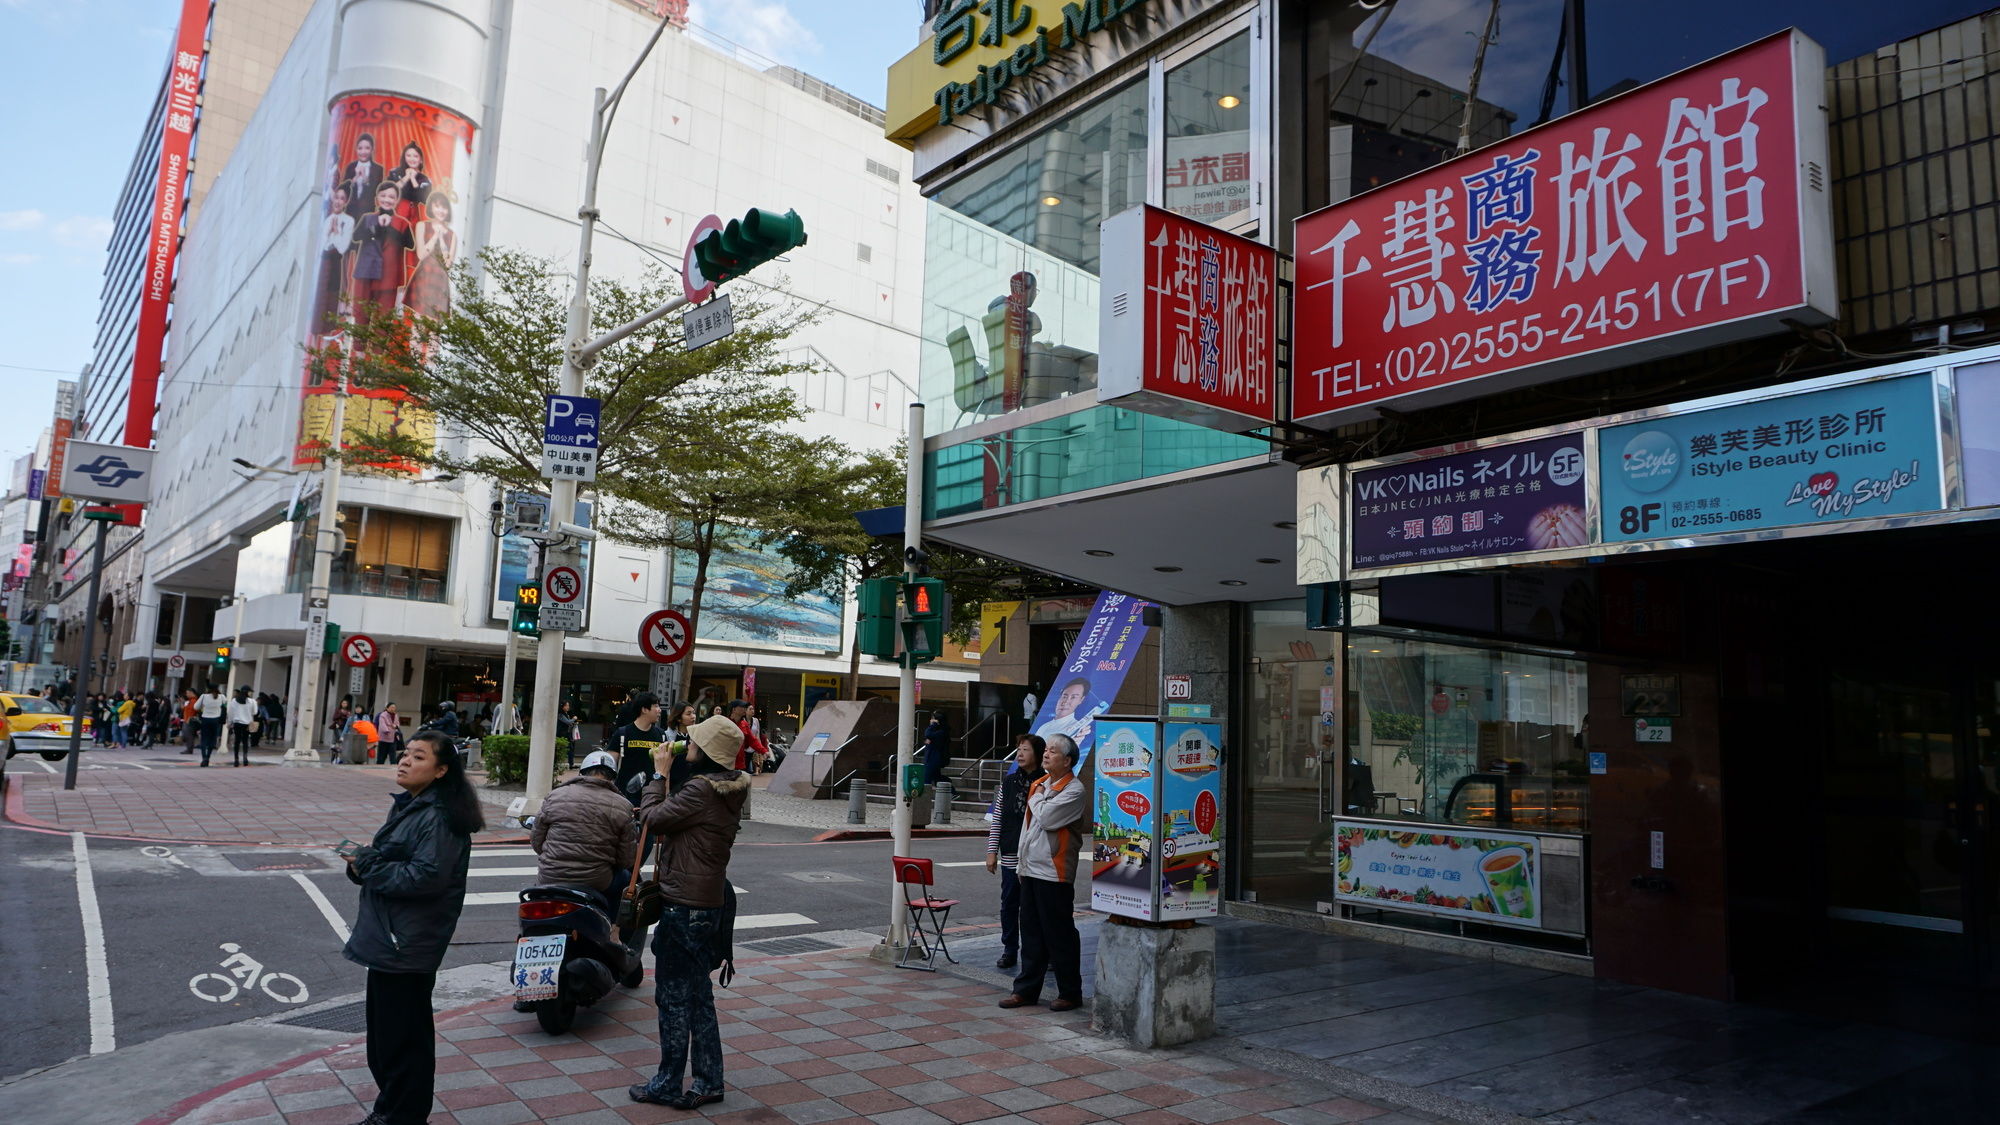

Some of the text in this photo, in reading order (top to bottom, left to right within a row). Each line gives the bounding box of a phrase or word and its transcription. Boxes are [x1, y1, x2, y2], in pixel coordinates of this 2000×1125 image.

[934, 26, 1050, 126] Taipei
[168, 51, 200, 134] 新光三越
[151, 153, 181, 301] SHIN KONG MITSUKOSHI
[549, 398, 574, 428] P
[547, 433, 575, 443] 100公尺
[1690, 407, 1887, 459] 樂芙美形診所
[547, 449, 592, 463] 中山美學
[1553, 453, 1579, 473] 5F
[1692, 440, 1887, 477] iStyle Beauty Clinic
[552, 464, 585, 477] 停車場
[1471, 452, 1544, 484] ネイル
[1786, 478, 1835, 506] Love
[1403, 510, 1484, 540] 預約制
[1620, 502, 1662, 535] 8F
[1671, 508, 1762, 528] 02-2555-0685
[1356, 555, 1375, 564] Line:
[519, 588, 537, 604] 49
[994, 616, 1007, 653] 1
[1069, 616, 1109, 673] Systema
[1171, 683, 1185, 696] 20
[1634, 692, 1670, 714] 22
[1649, 729, 1664, 740] 22
[1118, 742, 1135, 755] 酒後
[1185, 740, 1201, 751] 開車
[1177, 752, 1201, 765] 不超速
[1164, 843, 1174, 855] 50
[519, 944, 563, 960] 105-KZD
